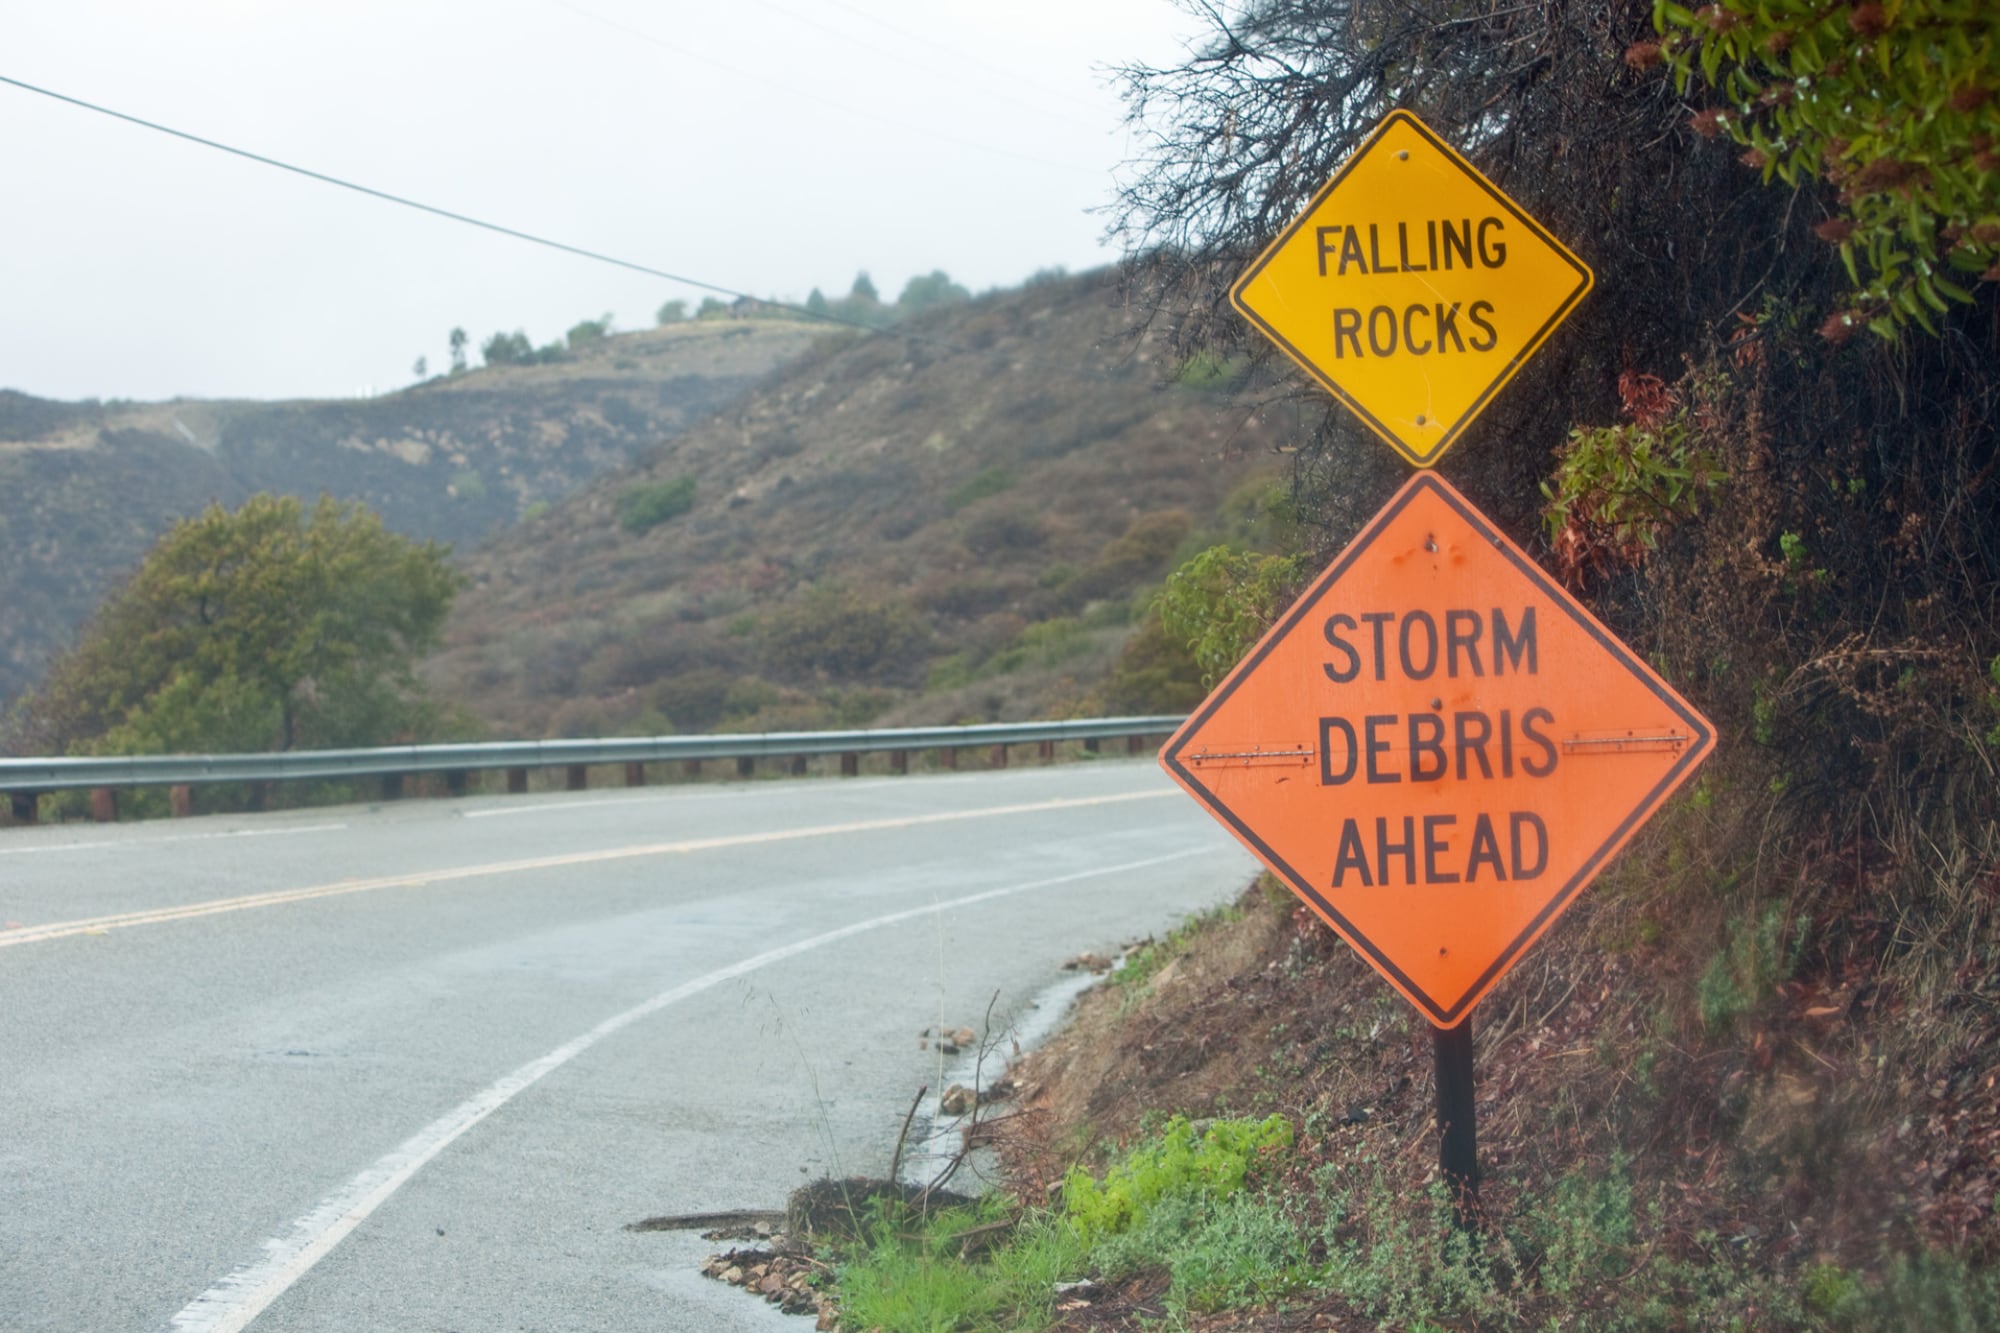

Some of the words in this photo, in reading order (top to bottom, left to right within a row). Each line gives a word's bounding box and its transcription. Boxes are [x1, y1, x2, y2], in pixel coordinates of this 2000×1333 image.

[1316, 216, 1507, 277] FALLING
[1333, 300, 1498, 359] ROCKS
[1322, 606, 1539, 684] STORM
[1318, 707, 1558, 786] DEBRIS
[1331, 811, 1549, 888] AHEAD
